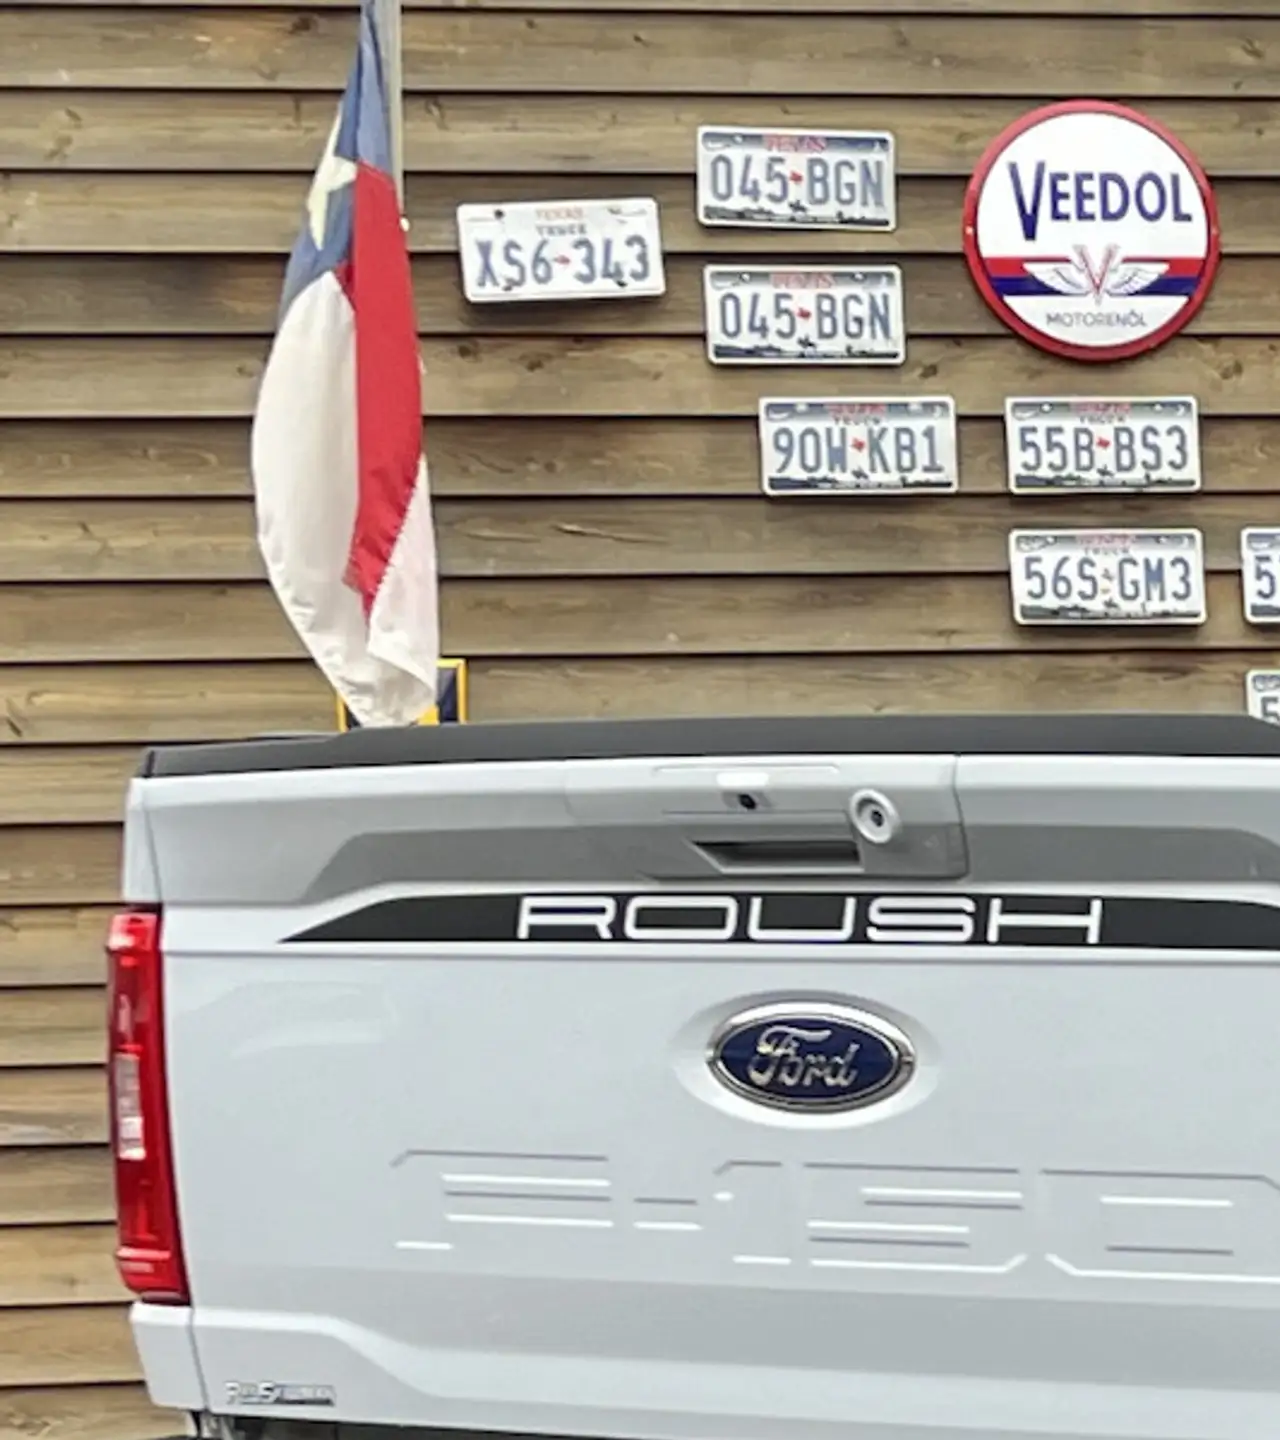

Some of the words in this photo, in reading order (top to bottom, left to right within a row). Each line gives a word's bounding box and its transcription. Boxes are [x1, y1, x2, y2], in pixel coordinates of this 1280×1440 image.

[711, 154, 788, 203] 045
[807, 157, 884, 207] BGN
[1008, 161, 1193, 241] VEEDOL
[720, 292, 796, 340] 045
[815, 292, 892, 340] BGN
[868, 425, 944, 474] KB1
[1018, 426, 1096, 472] 55B
[1113, 425, 1188, 472] BS3
[1024, 556, 1099, 601] 56S
[1117, 556, 1192, 601] GM3
[517, 895, 1103, 944] ROUSH
[747, 1024, 861, 1088] Ford
